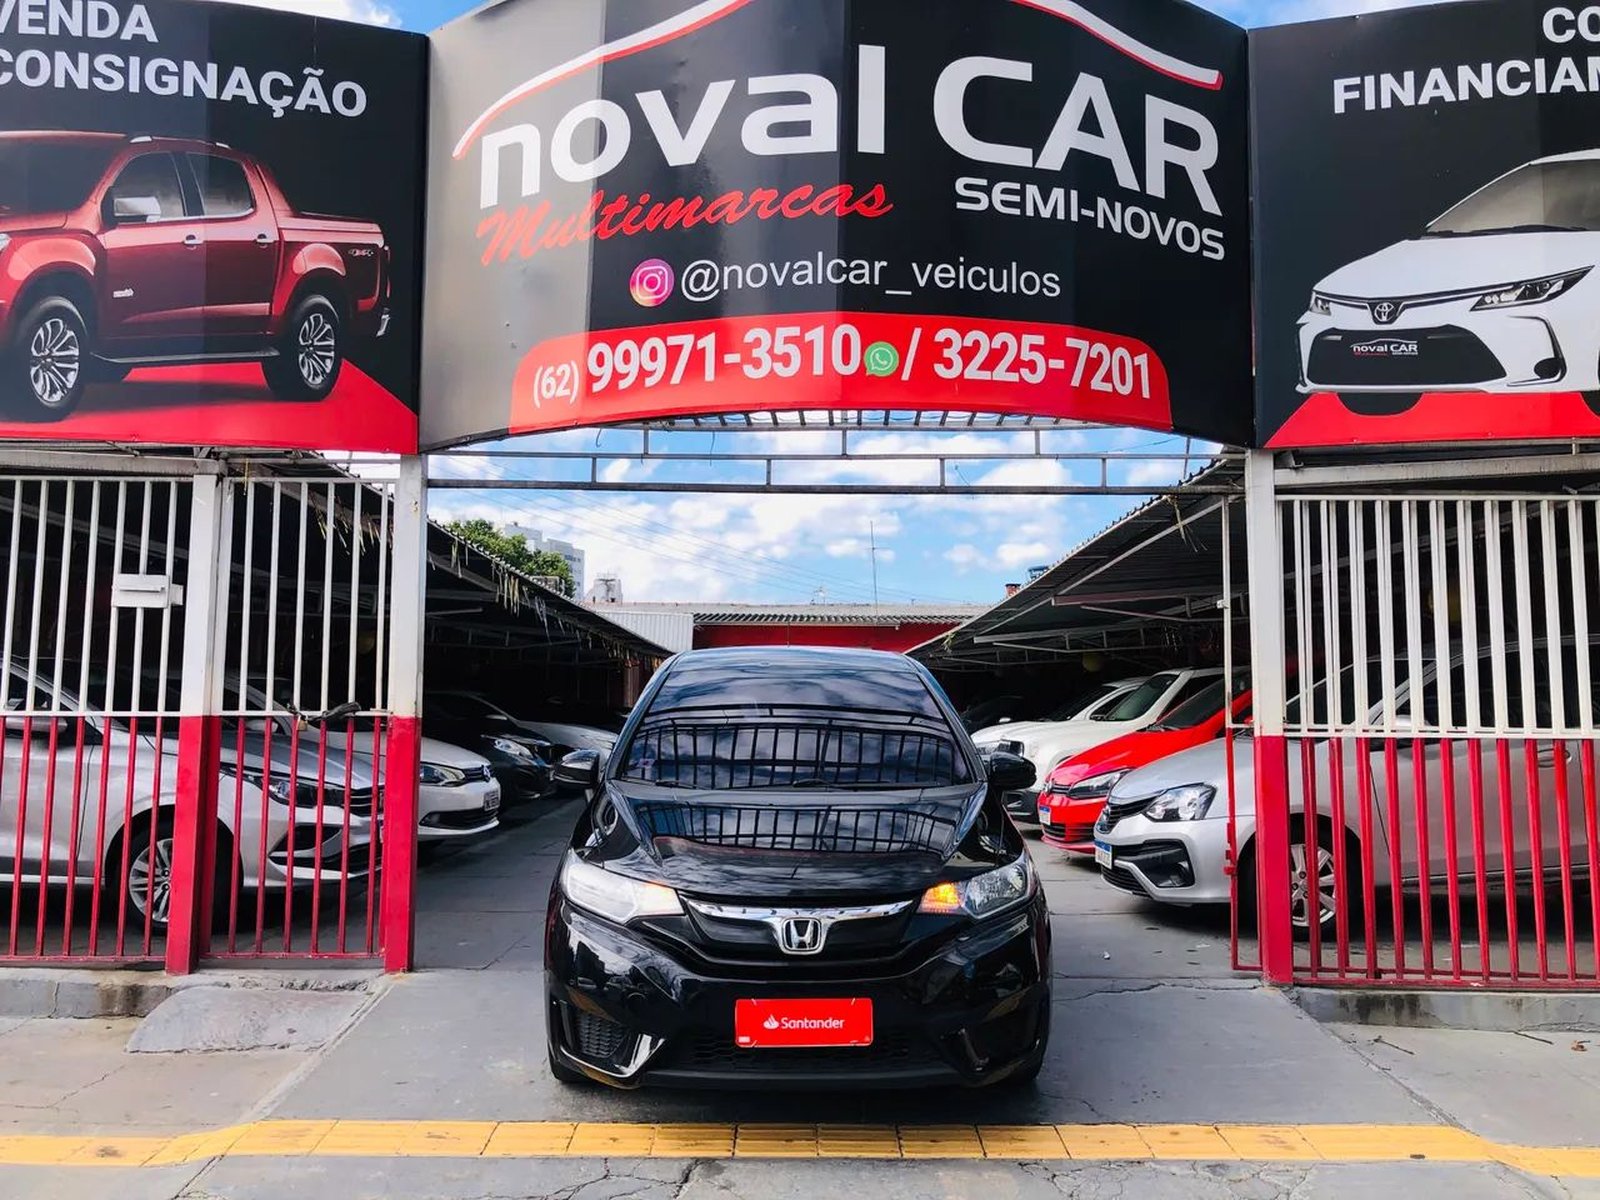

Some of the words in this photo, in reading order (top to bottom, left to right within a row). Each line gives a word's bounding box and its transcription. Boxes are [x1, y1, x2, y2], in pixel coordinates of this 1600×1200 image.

[480, 44, 886, 209] noval
[933, 56, 1222, 217] CAR
[475, 183, 894, 267] Multimarcas
[955, 177, 1225, 261] SEMI-NOVOS
[681, 251, 1061, 302] @novalcar_veiculos
[533, 360, 580, 408] (62)
[587, 323, 862, 393] 99971-3510
[933, 328, 1150, 400] 3225-7201
[1353, 344, 1388, 352] noval
[1390, 344, 1418, 352] CAR
[781, 1017, 845, 1030] Santander
